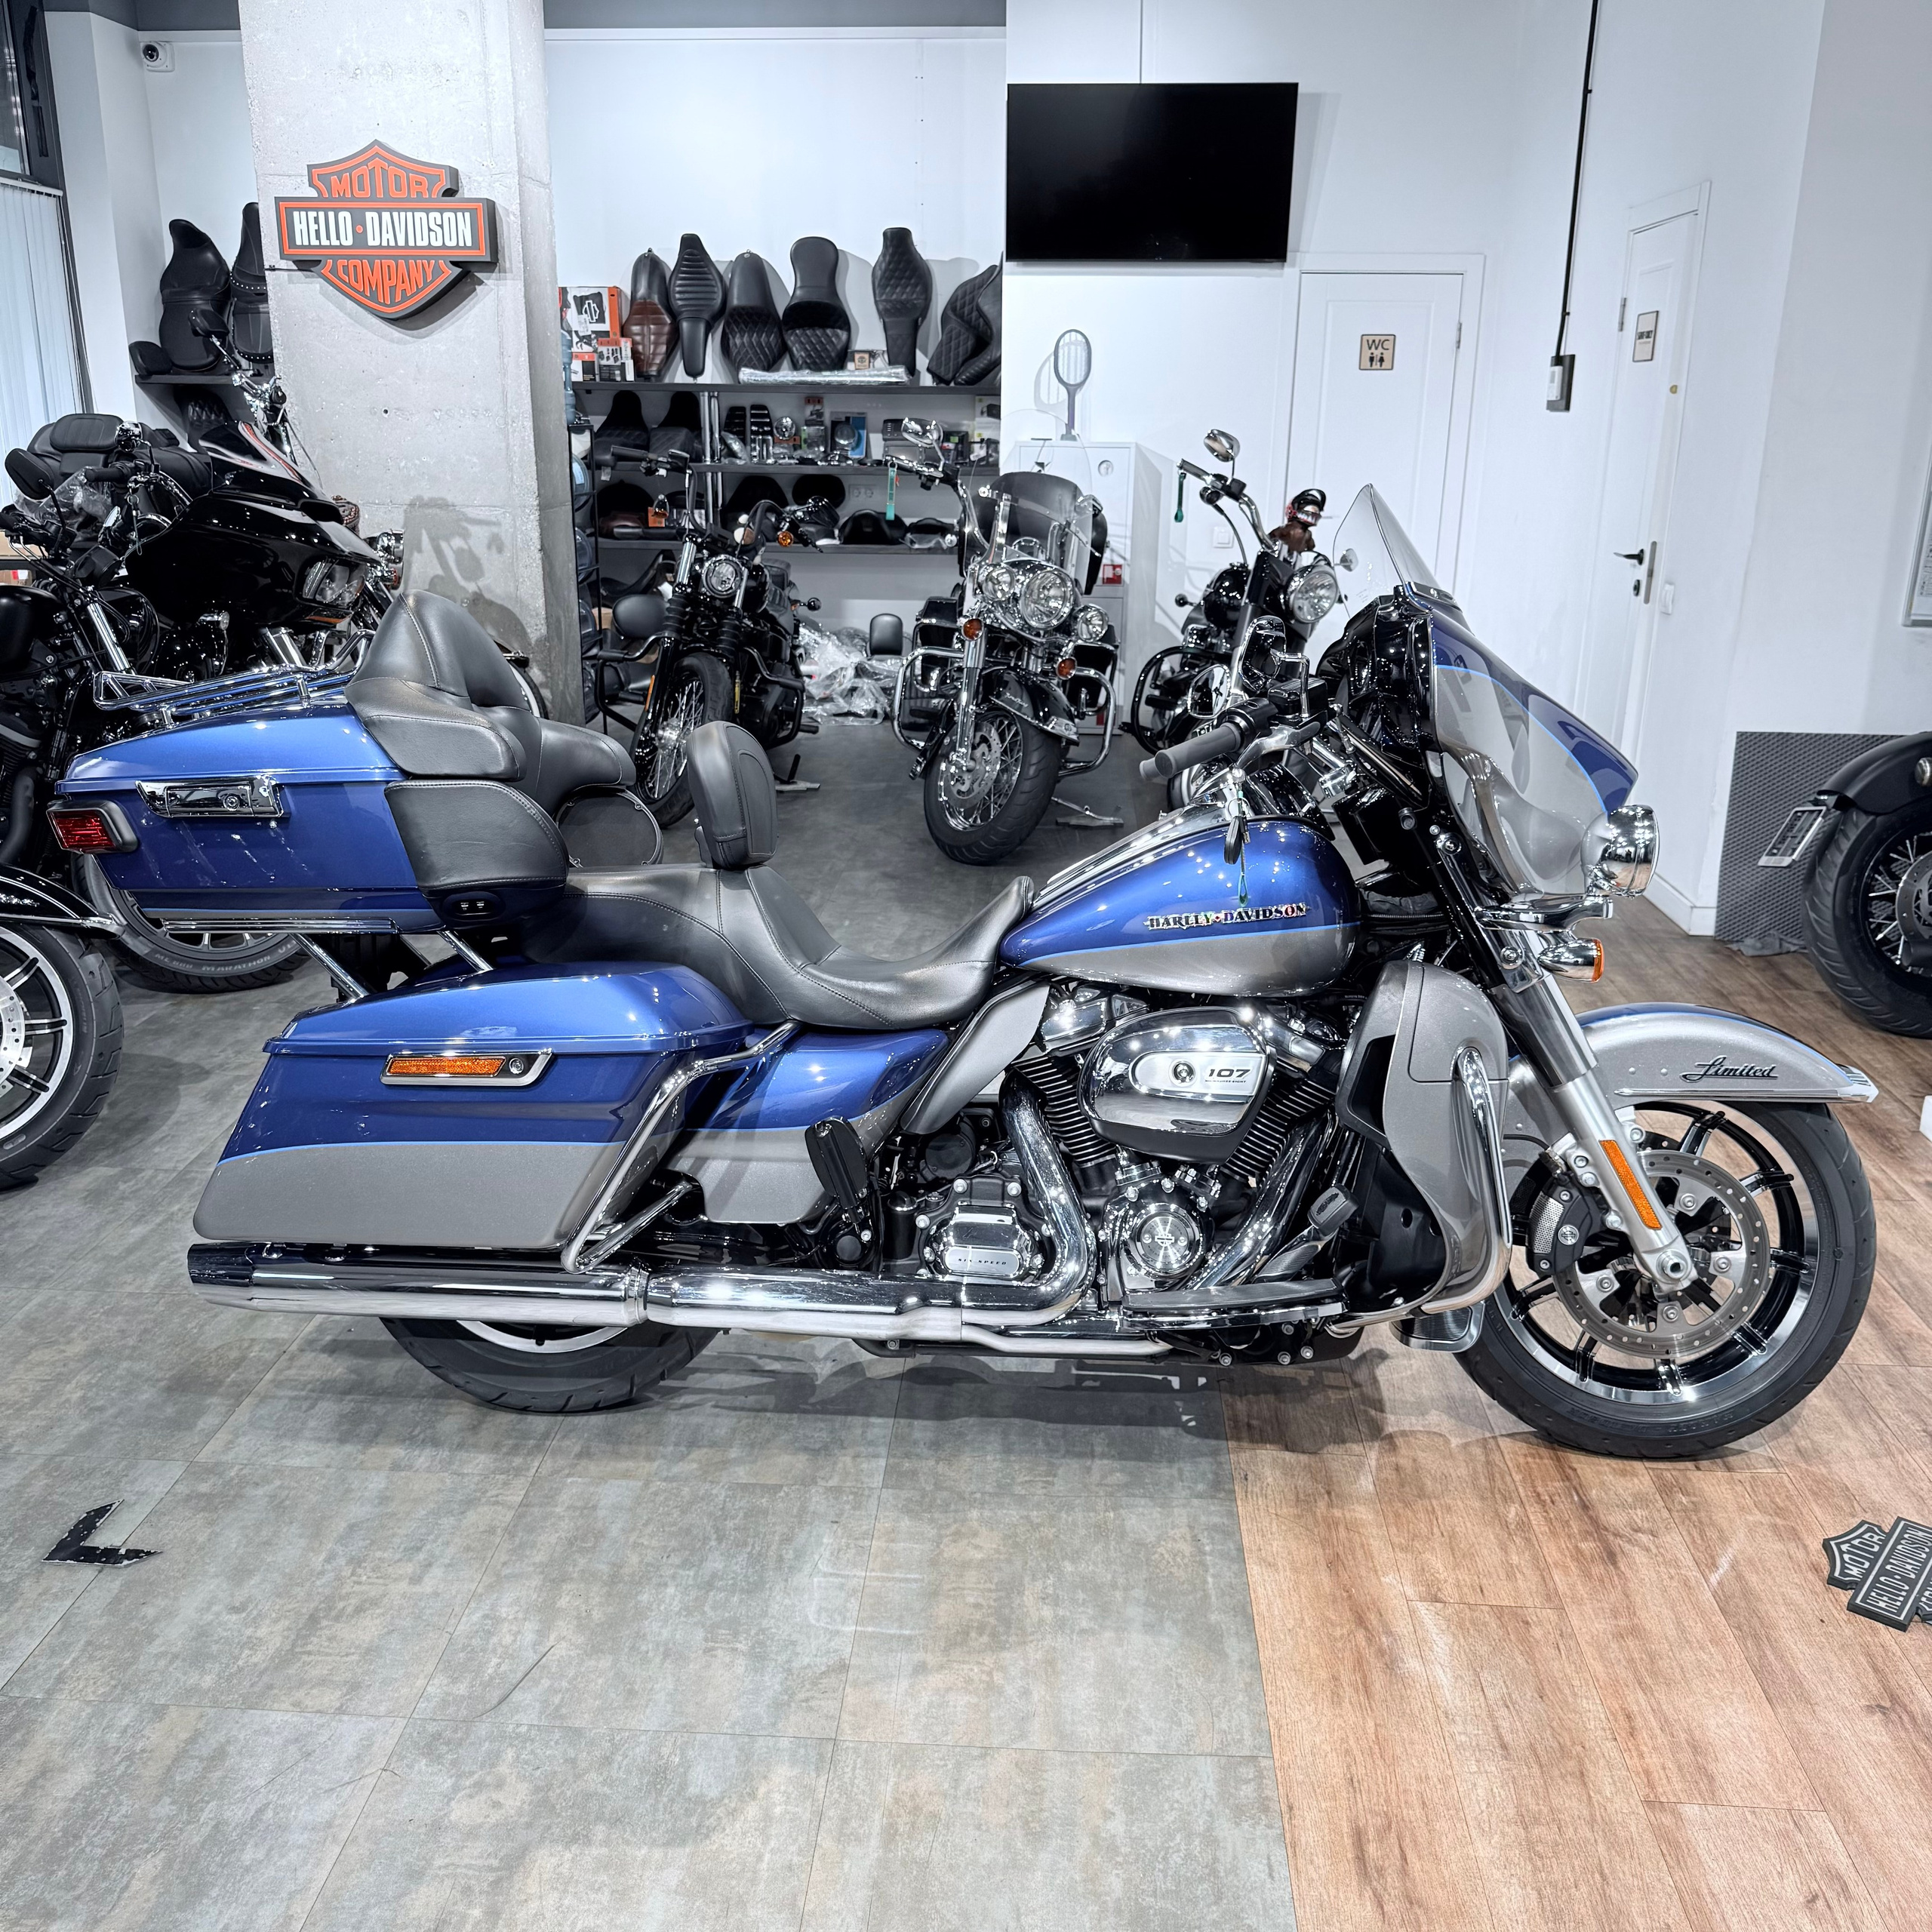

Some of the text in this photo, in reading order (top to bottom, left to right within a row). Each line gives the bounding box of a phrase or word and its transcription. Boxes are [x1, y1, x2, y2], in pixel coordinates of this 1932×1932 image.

[330, 157, 429, 198] MOTOR
[292, 211, 472, 247] HELLO DAVIDSON
[337, 259, 435, 305] COMPANY
[1366, 339, 1390, 351] WC
[1146, 902, 1307, 931] HARLEY DAVIDSON
[201, 955, 271, 972] MARATHON
[1208, 1068, 1251, 1078] 107
[1678, 1054, 1779, 1083] Limited
[1840, 1532, 1886, 1579] MOTOR
[1866, 1527, 1932, 1614] HELLO DAVIDSON
